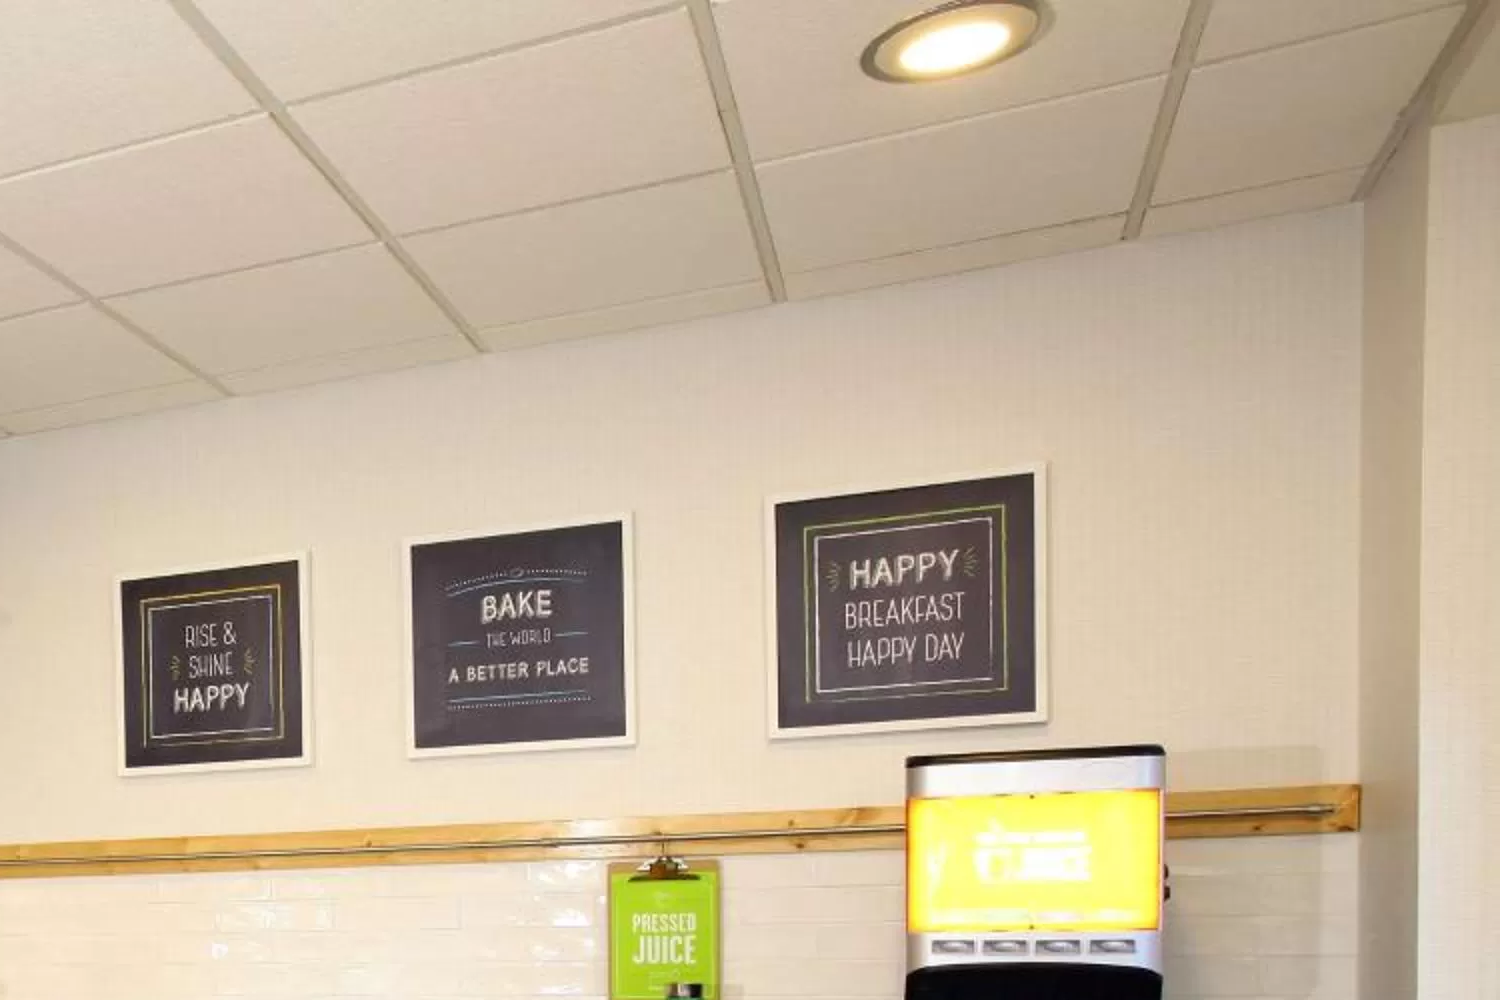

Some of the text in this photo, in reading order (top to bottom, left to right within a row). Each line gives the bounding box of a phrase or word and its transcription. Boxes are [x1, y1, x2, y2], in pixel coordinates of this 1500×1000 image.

[850, 549, 959, 590] HAPPY
[480, 589, 553, 624] BAKE
[845, 591, 965, 630] BREAKFAST
[185, 621, 237, 648] RISE &
[486, 627, 551, 649] THE WORLD
[847, 632, 965, 668] HAPPY DAY
[189, 652, 233, 679] SHINE
[448, 657, 589, 684] A BETTER PLACE
[174, 683, 250, 714] HAPPY
[632, 911, 697, 934] PRESSED
[632, 934, 697, 965] JUICE
